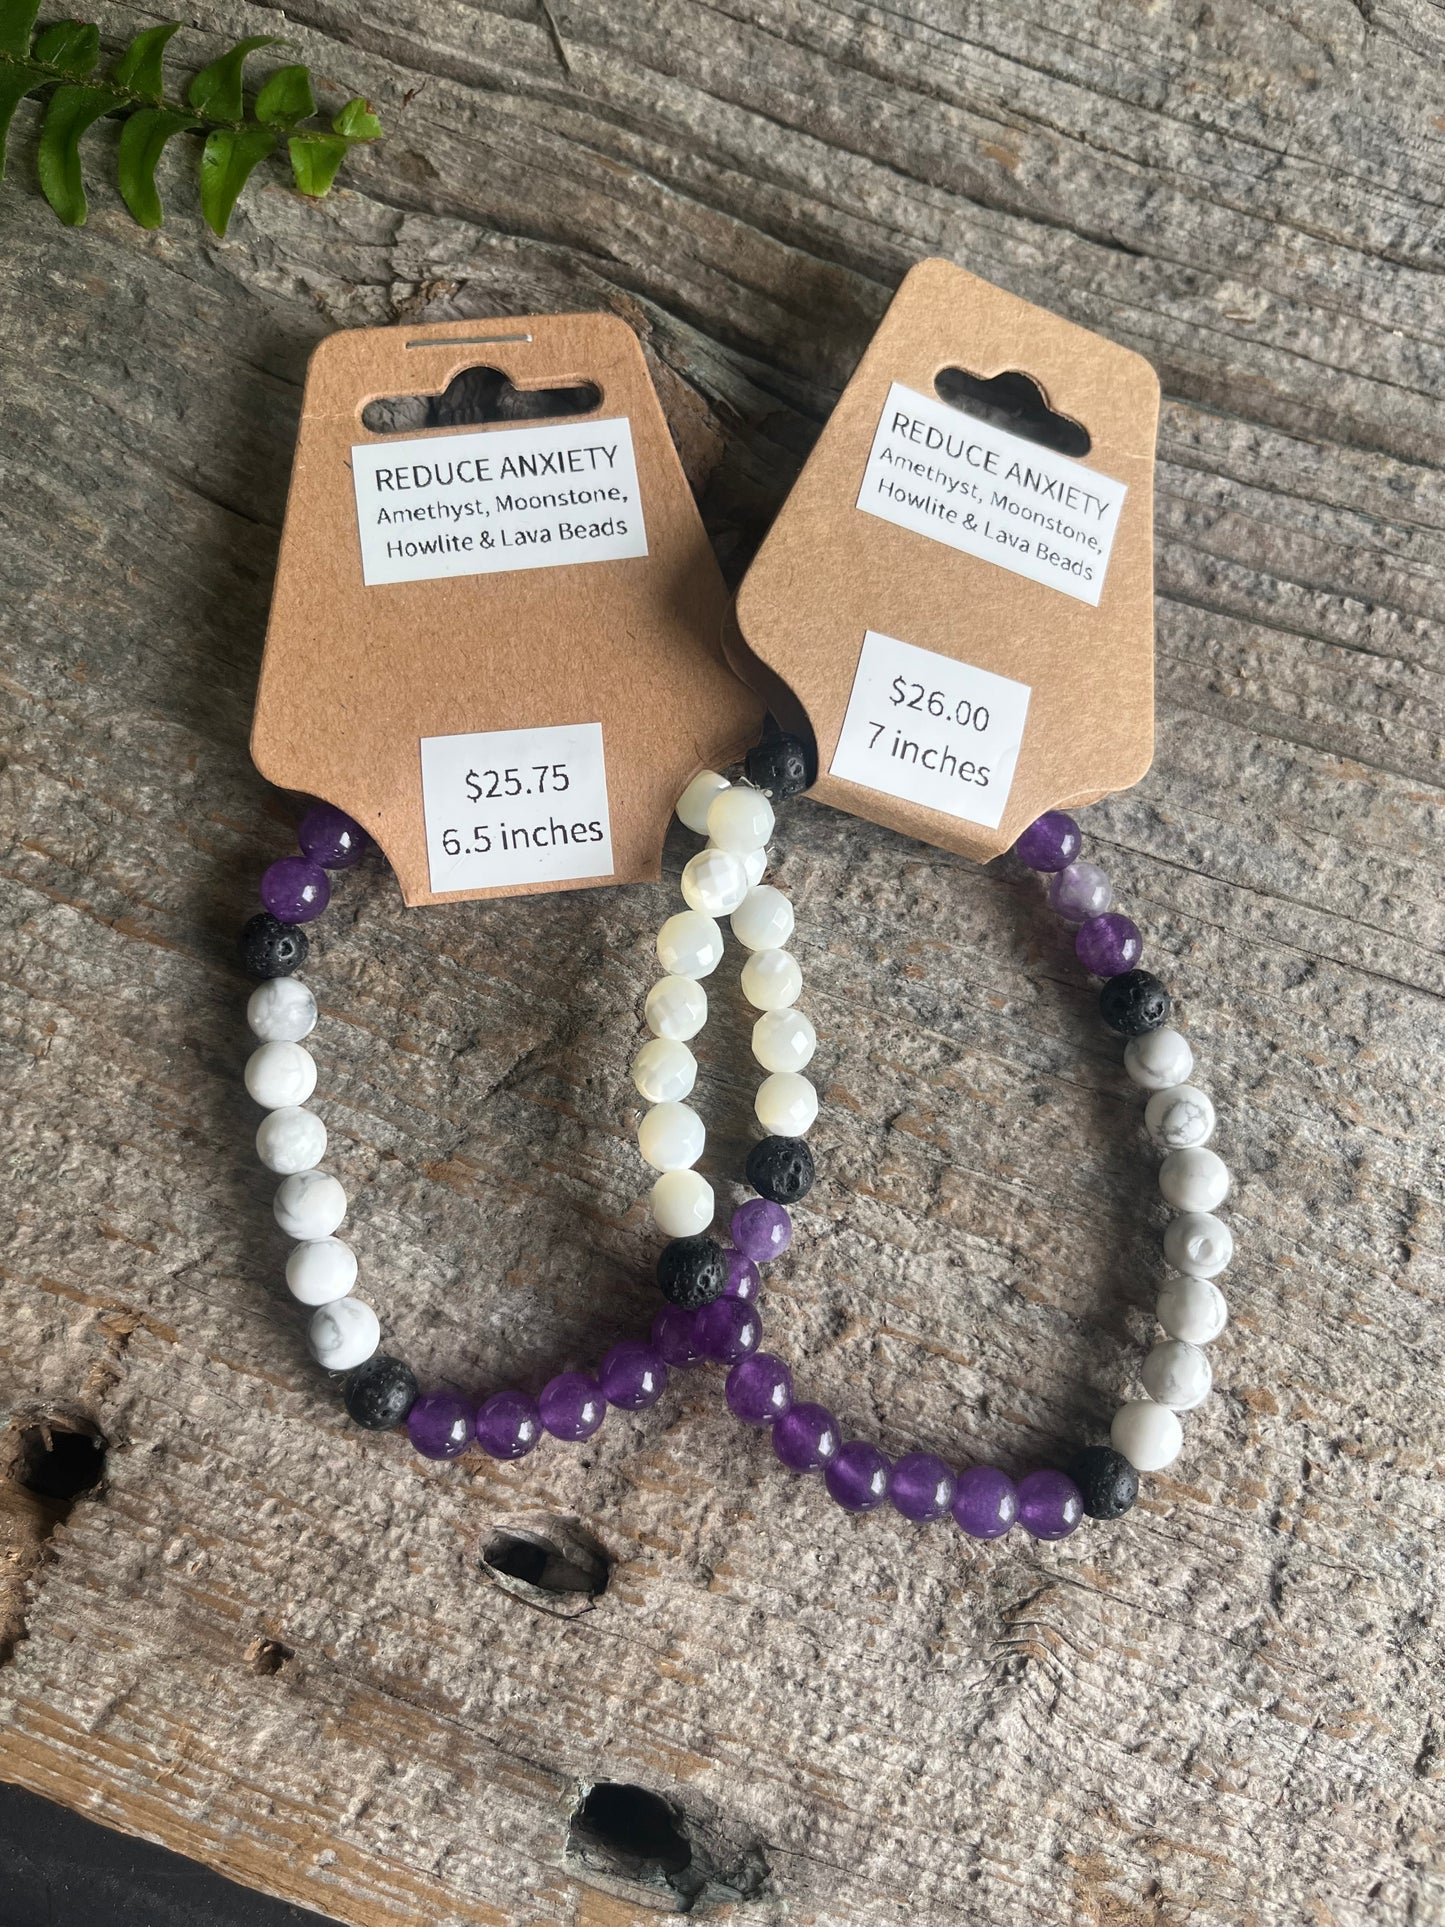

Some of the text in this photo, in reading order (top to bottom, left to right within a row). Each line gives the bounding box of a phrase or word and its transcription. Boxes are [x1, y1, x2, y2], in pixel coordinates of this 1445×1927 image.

[375, 445, 618, 491] REDUCE ANXIETY
[891, 411, 1110, 521] REDUCE ANXIETY
[377, 486, 628, 525] Amethyst, Moonstone,
[879, 447, 1102, 555] Amethyst, Moonstone,
[387, 517, 628, 558] Howlite & Lava Beads
[878, 477, 1093, 581] Howlite & Lava Beads
[889, 675, 990, 732] $26.00
[869, 721, 991, 787] 7 inches
[465, 764, 570, 803] $25.75
[442, 816, 604, 855] 6.5 inches
